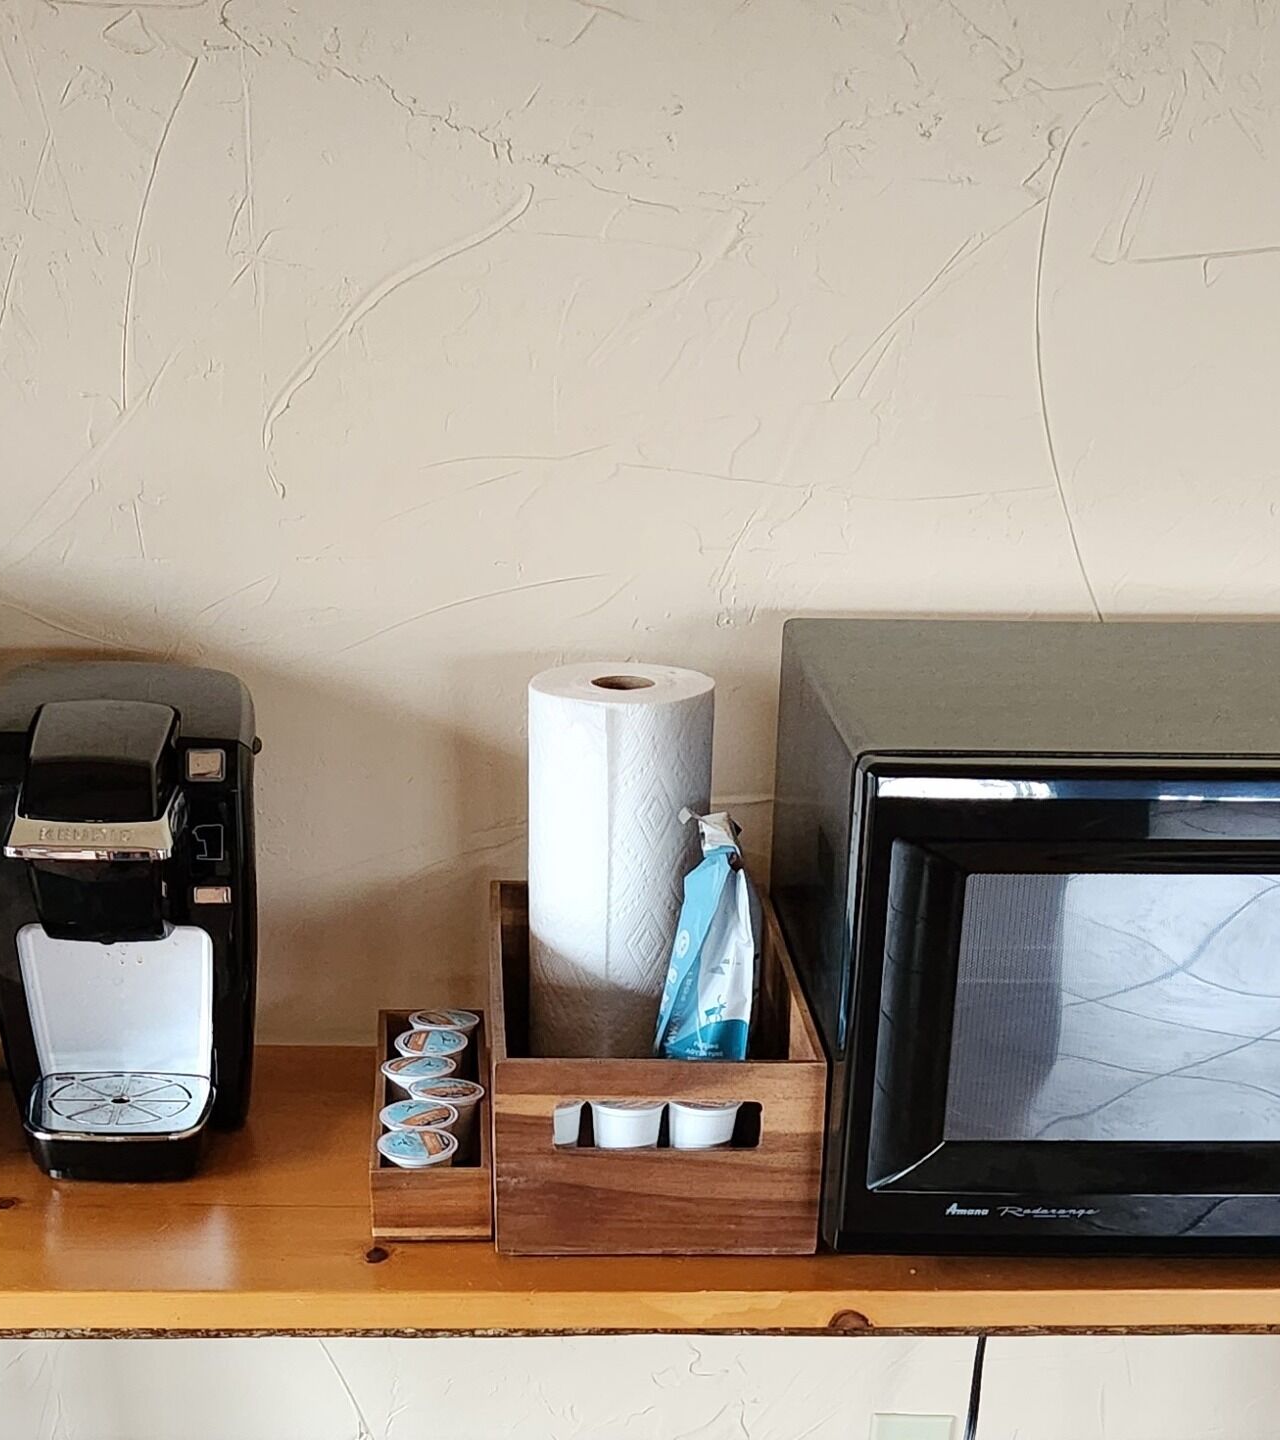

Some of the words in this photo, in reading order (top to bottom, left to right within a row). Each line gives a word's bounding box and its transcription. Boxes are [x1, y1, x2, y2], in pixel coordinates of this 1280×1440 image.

[38, 826, 133, 842] KEURIG
[945, 1202, 990, 1216] Amana
[996, 1205, 1101, 1219] Radarange
